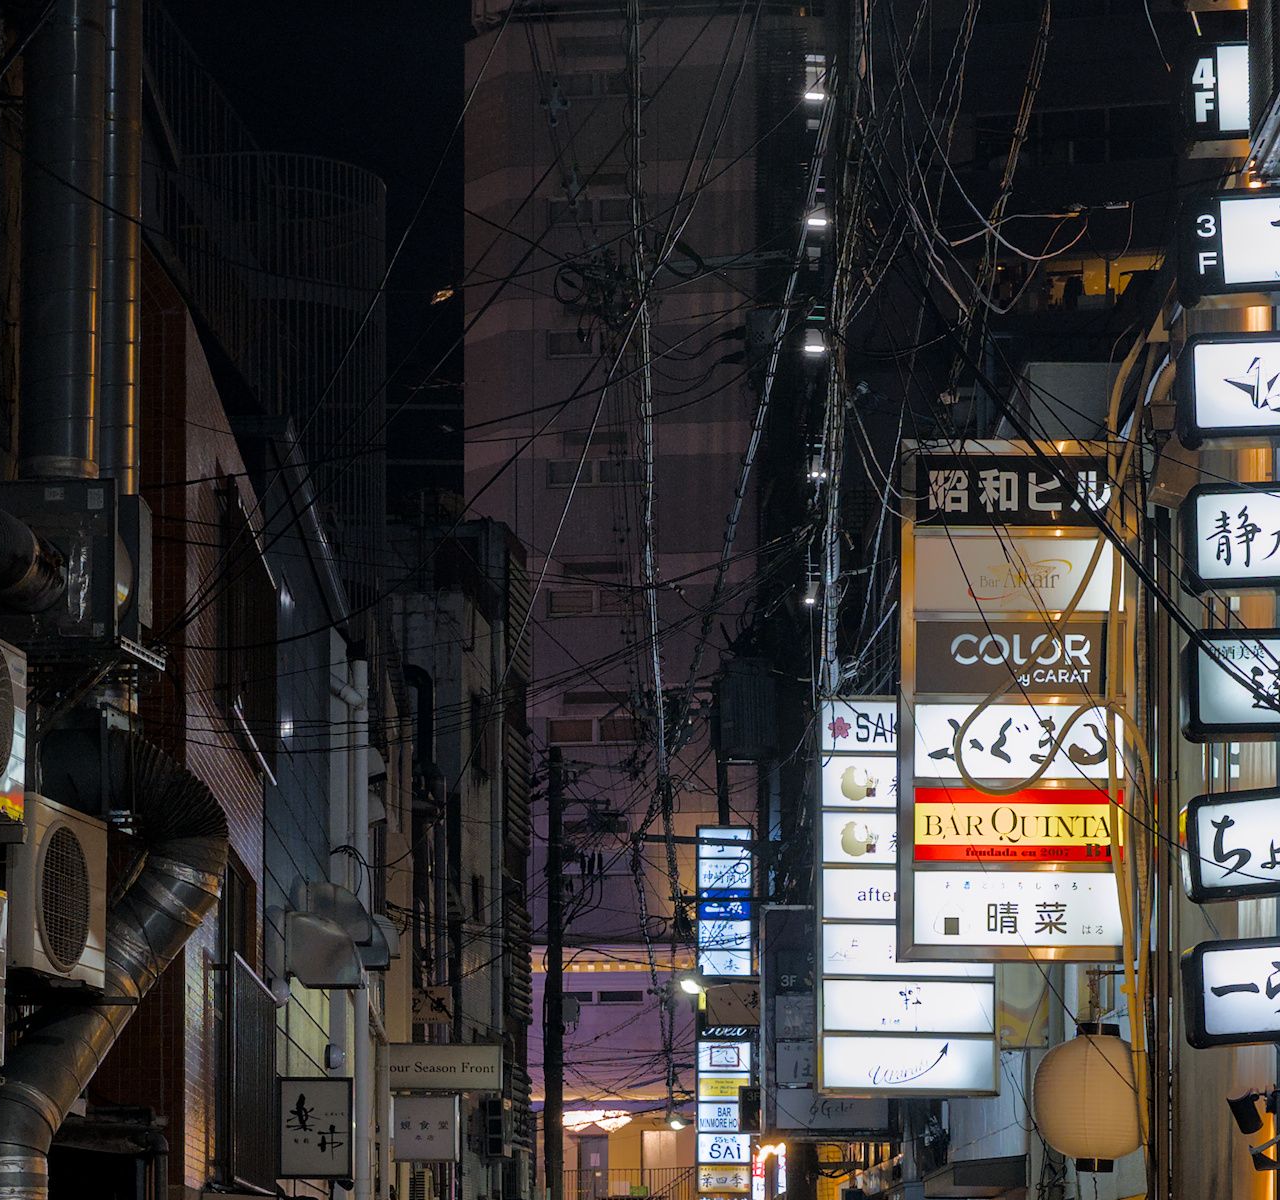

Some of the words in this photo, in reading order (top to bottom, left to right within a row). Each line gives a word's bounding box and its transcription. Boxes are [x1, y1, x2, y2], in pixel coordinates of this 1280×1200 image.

[928, 468, 1112, 513] 昭和ビル
[980, 575, 1000, 588] Bar
[951, 634, 1091, 666] COLOR
[1033, 669, 1091, 684] CARAT
[923, 813, 984, 837] BAR
[991, 807, 1111, 842] QUINTA
[987, 902, 1067, 934] 晴菜
[385, 1064, 410, 1073] our
[414, 1061, 457, 1073] Season
[461, 1061, 495, 1073] Front
[717, 1107, 732, 1117] BAR
